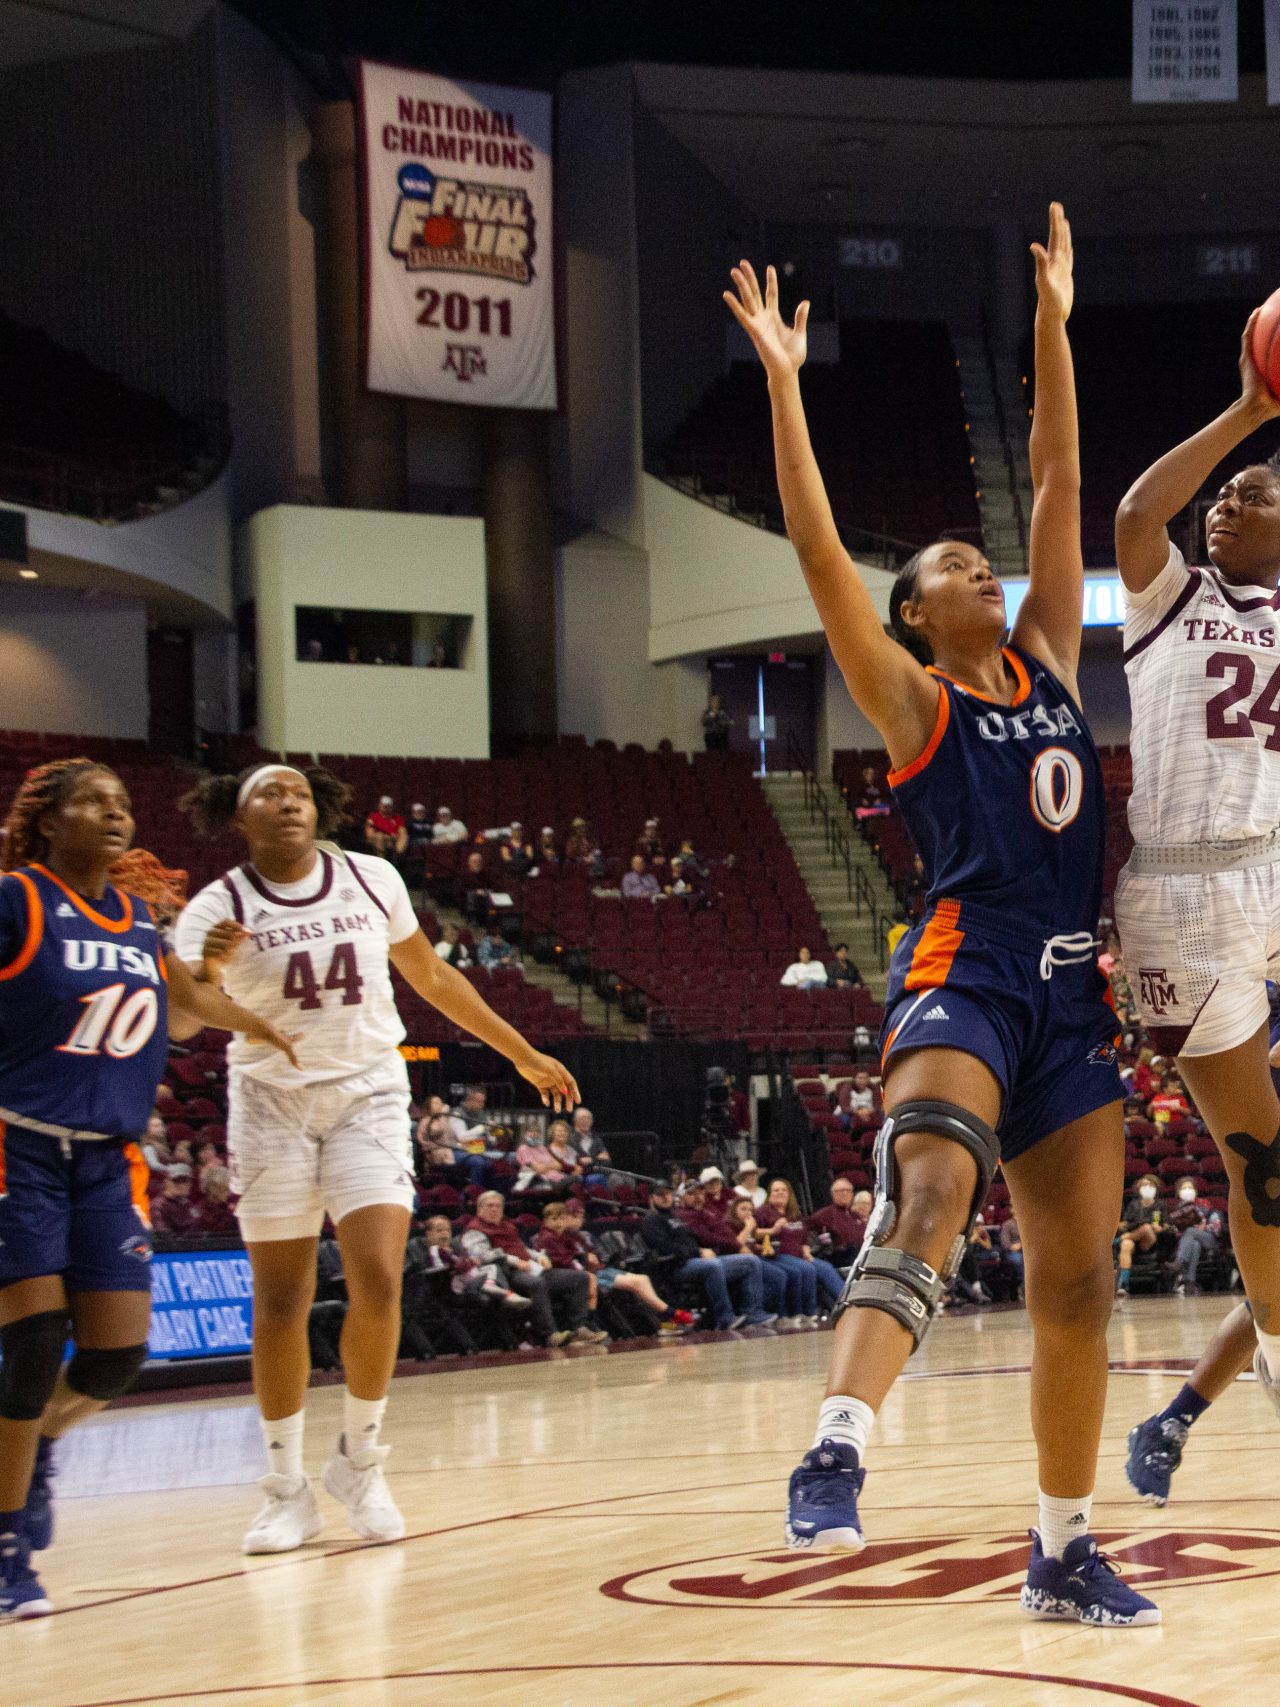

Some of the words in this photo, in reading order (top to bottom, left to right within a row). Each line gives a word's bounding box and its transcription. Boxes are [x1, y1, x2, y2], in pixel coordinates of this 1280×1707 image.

[397, 95, 519, 140] NATIONAL
[382, 123, 534, 172] CHAMPIONS
[415, 287, 513, 338] 2011
[1183, 618, 1276, 648] TEXAS
[976, 702, 1082, 743] UTSA
[1030, 745, 1084, 833] 0
[251, 922, 325, 952] TEXAS
[63, 939, 161, 985] UTSA
[283, 942, 365, 1011] 44
[54, 982, 159, 1059] 10
